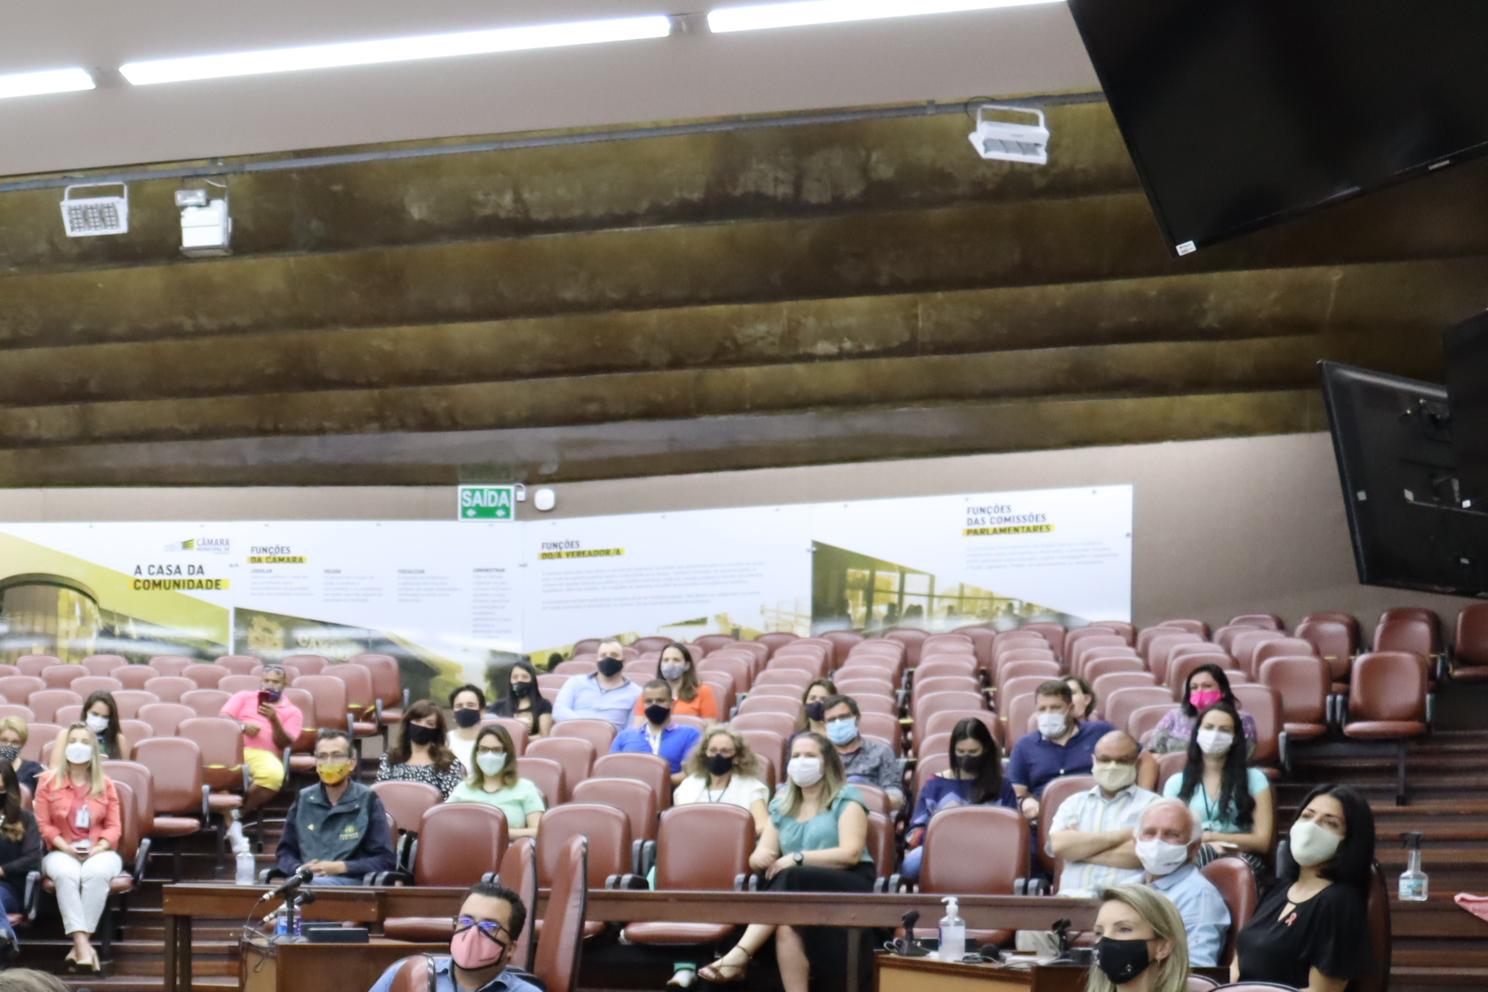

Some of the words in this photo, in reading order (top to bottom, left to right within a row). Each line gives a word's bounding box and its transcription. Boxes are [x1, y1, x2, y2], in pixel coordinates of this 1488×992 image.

[463, 489, 510, 507] SAÍDA
[967, 505, 1012, 515] FUNÇÕES
[967, 517, 986, 526] DAS
[990, 513, 1047, 525] COMISSÕES
[966, 525, 1051, 536] PARLAMENTARES
[250, 545, 291, 556] FUNÇÕES
[542, 541, 580, 550] FUNÇÕES
[134, 565, 143, 576] A
[147, 565, 182, 576] CASA
[187, 565, 205, 576] DA
[133, 579, 222, 590] COMUNIDADE
